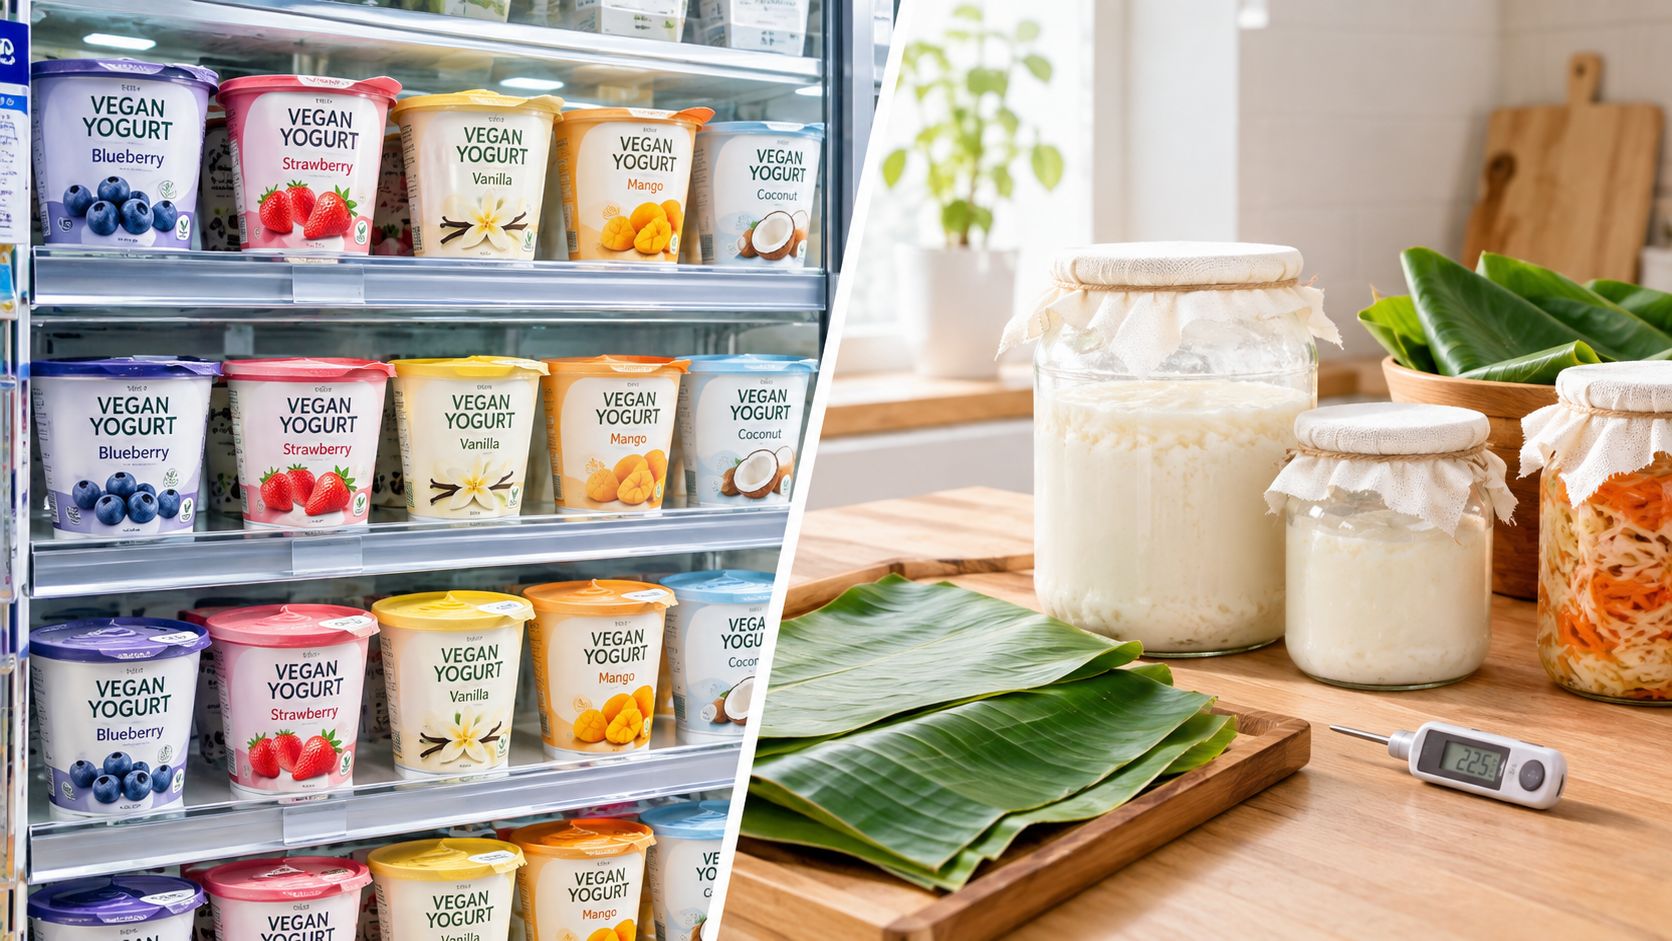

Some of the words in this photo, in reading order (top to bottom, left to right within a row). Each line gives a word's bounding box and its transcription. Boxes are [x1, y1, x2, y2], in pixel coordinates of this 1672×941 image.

[91, 96, 165, 117] VEGAN
[288, 108, 352, 128] VEGAN
[83, 117, 173, 140] YOGURT
[464, 127, 523, 145] VEGAN
[280, 128, 359, 150] YOGURT
[620, 136, 672, 154] VEGAN
[92, 148, 165, 168] Blueberry
[456, 145, 528, 165] YOGURT
[612, 154, 677, 172] YOGURT
[756, 149, 803, 165] VEGAN
[283, 157, 353, 176] Strawberry
[750, 165, 806, 183] YOGURT
[472, 172, 512, 186] Vanilla
[627, 178, 664, 194] Mango
[756, 189, 798, 201] Coconut
[97, 396, 169, 415] VEGAN
[287, 397, 351, 414] VEGAN
[451, 393, 510, 411] VEGAN
[603, 391, 656, 408] VEGAN
[737, 389, 787, 404] VEGAN
[445, 411, 515, 430] YOGURT
[596, 408, 661, 425] YOGURT
[731, 404, 791, 421] YOGURT
[89, 416, 177, 436] YOGURT
[280, 415, 358, 434] YOGURT
[610, 432, 647, 447] Mango
[738, 428, 782, 440] Coconut
[283, 443, 351, 457] Strawberry
[460, 437, 500, 450] Vanilla
[99, 446, 169, 462] Blueberry
[728, 615, 766, 633] VEGA
[591, 629, 644, 646] VEGAN
[721, 633, 763, 650] YOGU
[441, 644, 498, 663] VEGAN
[584, 645, 648, 665] YOGURT
[728, 656, 760, 668] Coco
[275, 660, 338, 680] VEGAN
[434, 661, 503, 682] YOGURT
[598, 671, 635, 685] Mango
[96, 677, 165, 698] VEGAN
[267, 677, 344, 700] YOGURT
[449, 689, 489, 702] Vanilla
[88, 695, 171, 718] YOGURT
[271, 706, 339, 721] Strawberry
[96, 726, 164, 741] Blueberry
[574, 868, 625, 886] VEGAN
[432, 891, 489, 909] VEGAN
[568, 883, 629, 902] YOGURT
[267, 911, 329, 931] VEGAN
[426, 907, 494, 928] YOGURT
[582, 907, 617, 921] Mango
